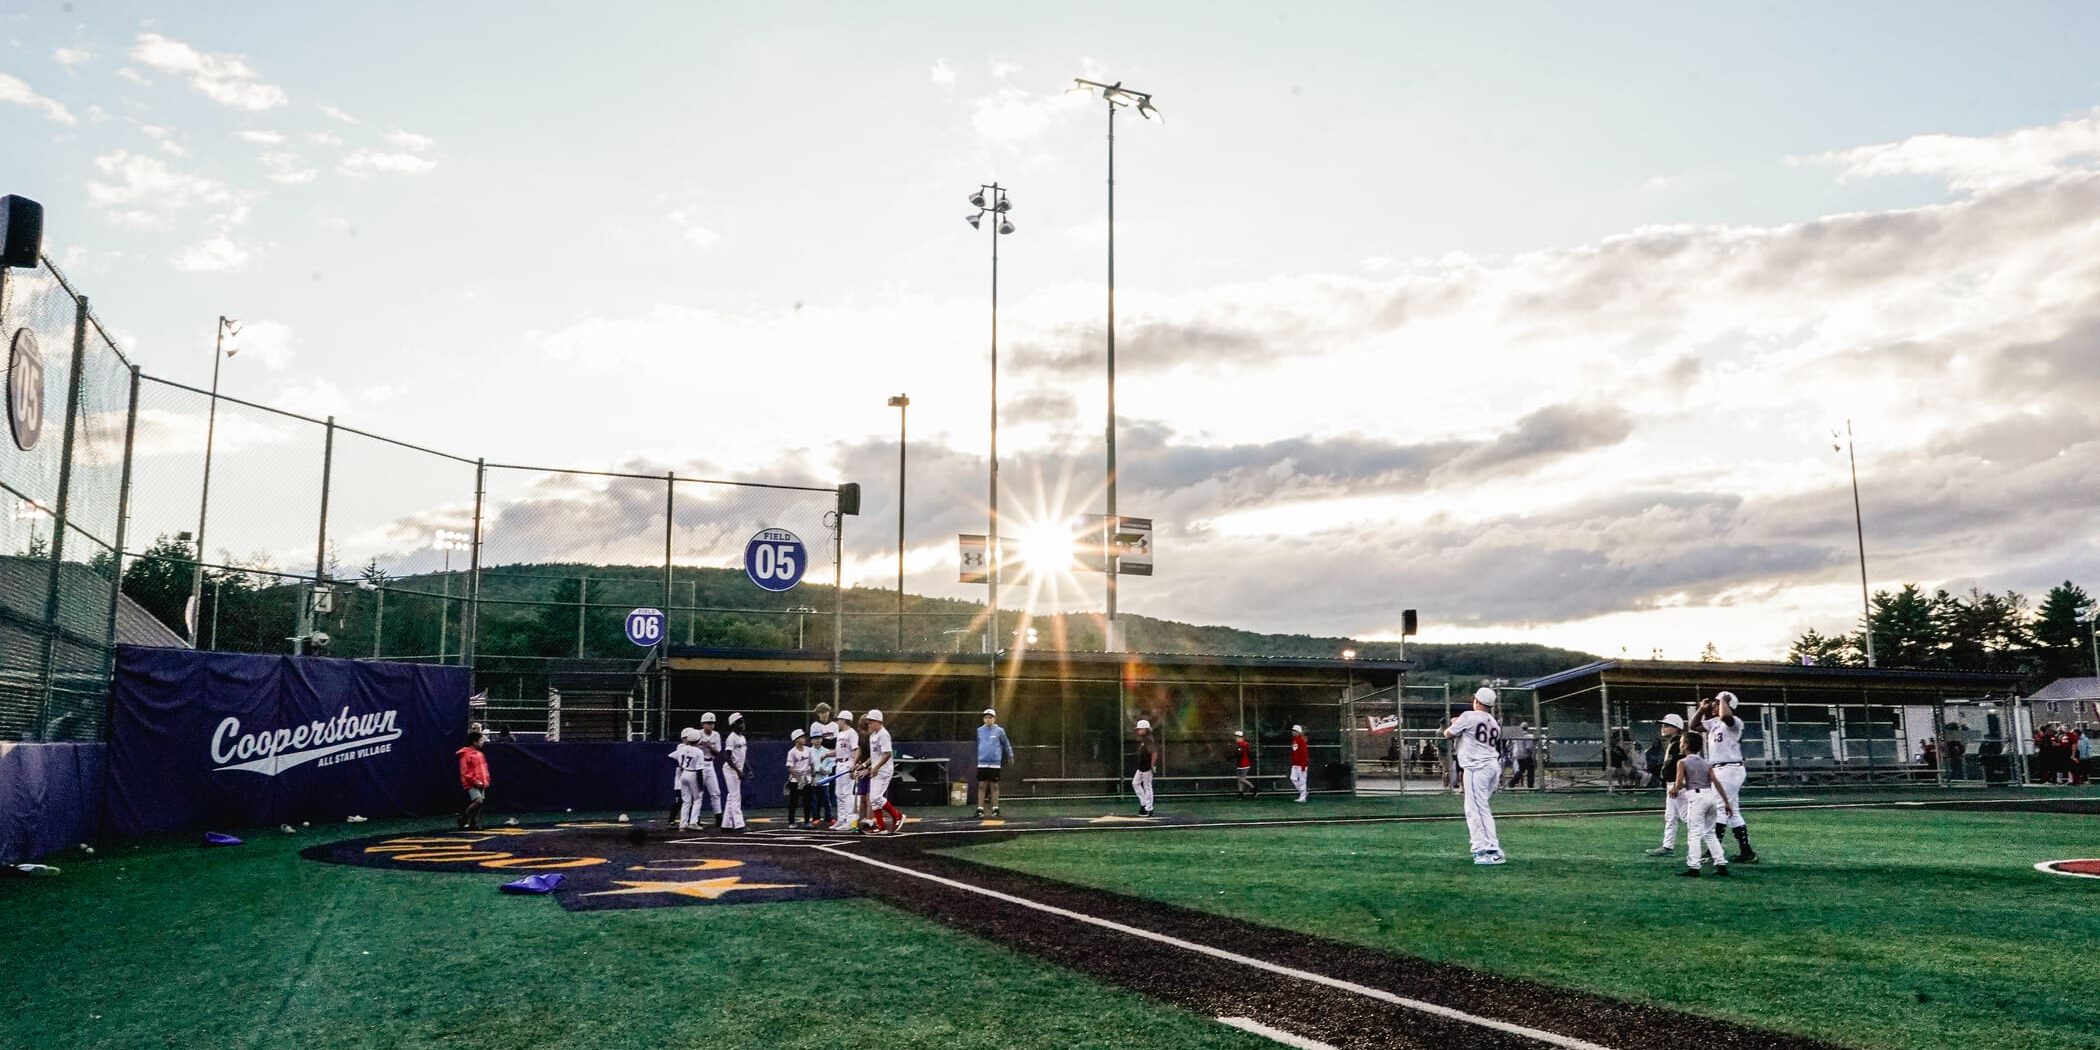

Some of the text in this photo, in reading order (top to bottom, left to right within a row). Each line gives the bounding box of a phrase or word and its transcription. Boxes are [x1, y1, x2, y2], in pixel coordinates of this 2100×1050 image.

[17, 354, 39, 431] 05
[764, 532, 791, 541] FIELD
[755, 543, 796, 580] 05
[632, 616, 659, 639] 06
[211, 706, 398, 764] Cooperstown
[1475, 722, 1499, 747] 68
[317, 744, 392, 768] ALL STAR VILLAGE
[681, 754, 693, 768] 17
